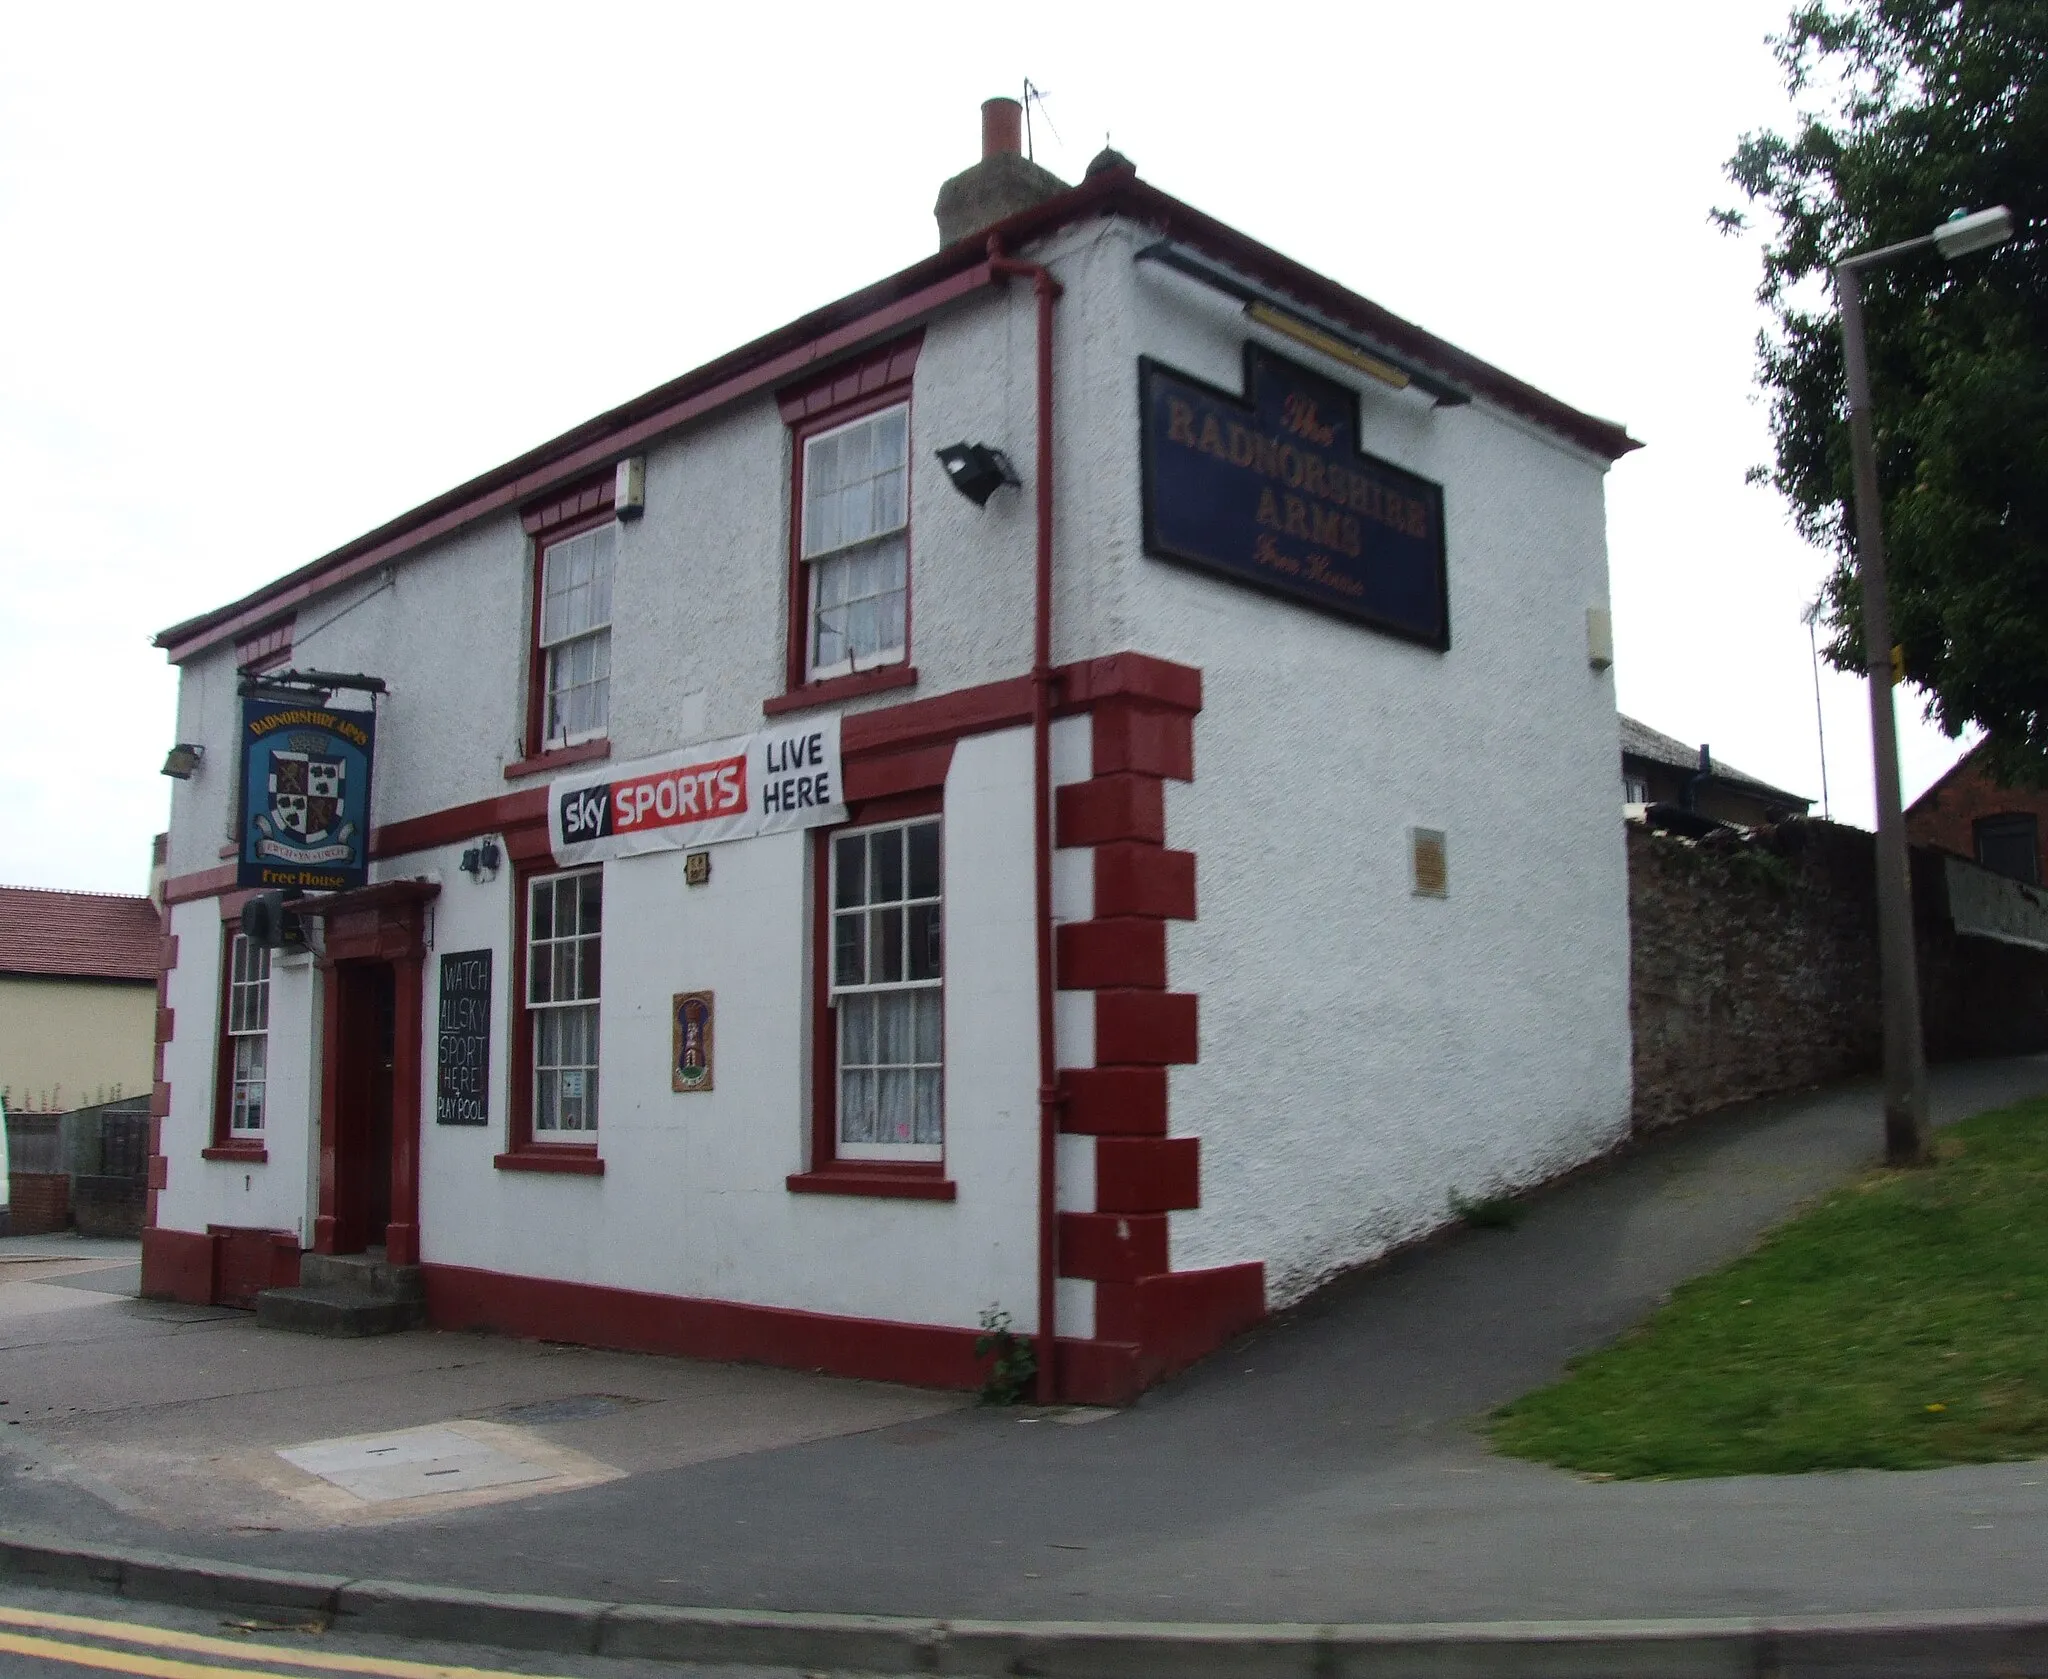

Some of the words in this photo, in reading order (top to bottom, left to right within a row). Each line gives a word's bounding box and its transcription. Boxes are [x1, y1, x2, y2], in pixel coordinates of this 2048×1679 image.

[1166, 396, 1427, 540] RADNORSHIRE
[1256, 486, 1362, 558] ARMS
[250, 710, 338, 736] RADNORSHIRE
[766, 732, 824, 774] LIVE
[565, 791, 608, 837] sky
[615, 765, 740, 827] SPORTS
[763, 771, 831, 815] HERE
[262, 869, 296, 885] Free
[299, 872, 345, 887] House
[444, 960, 488, 991] WATCH
[440, 999, 461, 1031] ALL
[460, 997, 488, 1033] SKY
[440, 1035, 486, 1067] SPORT
[444, 1066, 482, 1093] HERE
[438, 1096, 457, 1119] PLAY
[457, 1097, 485, 1120] POOL
